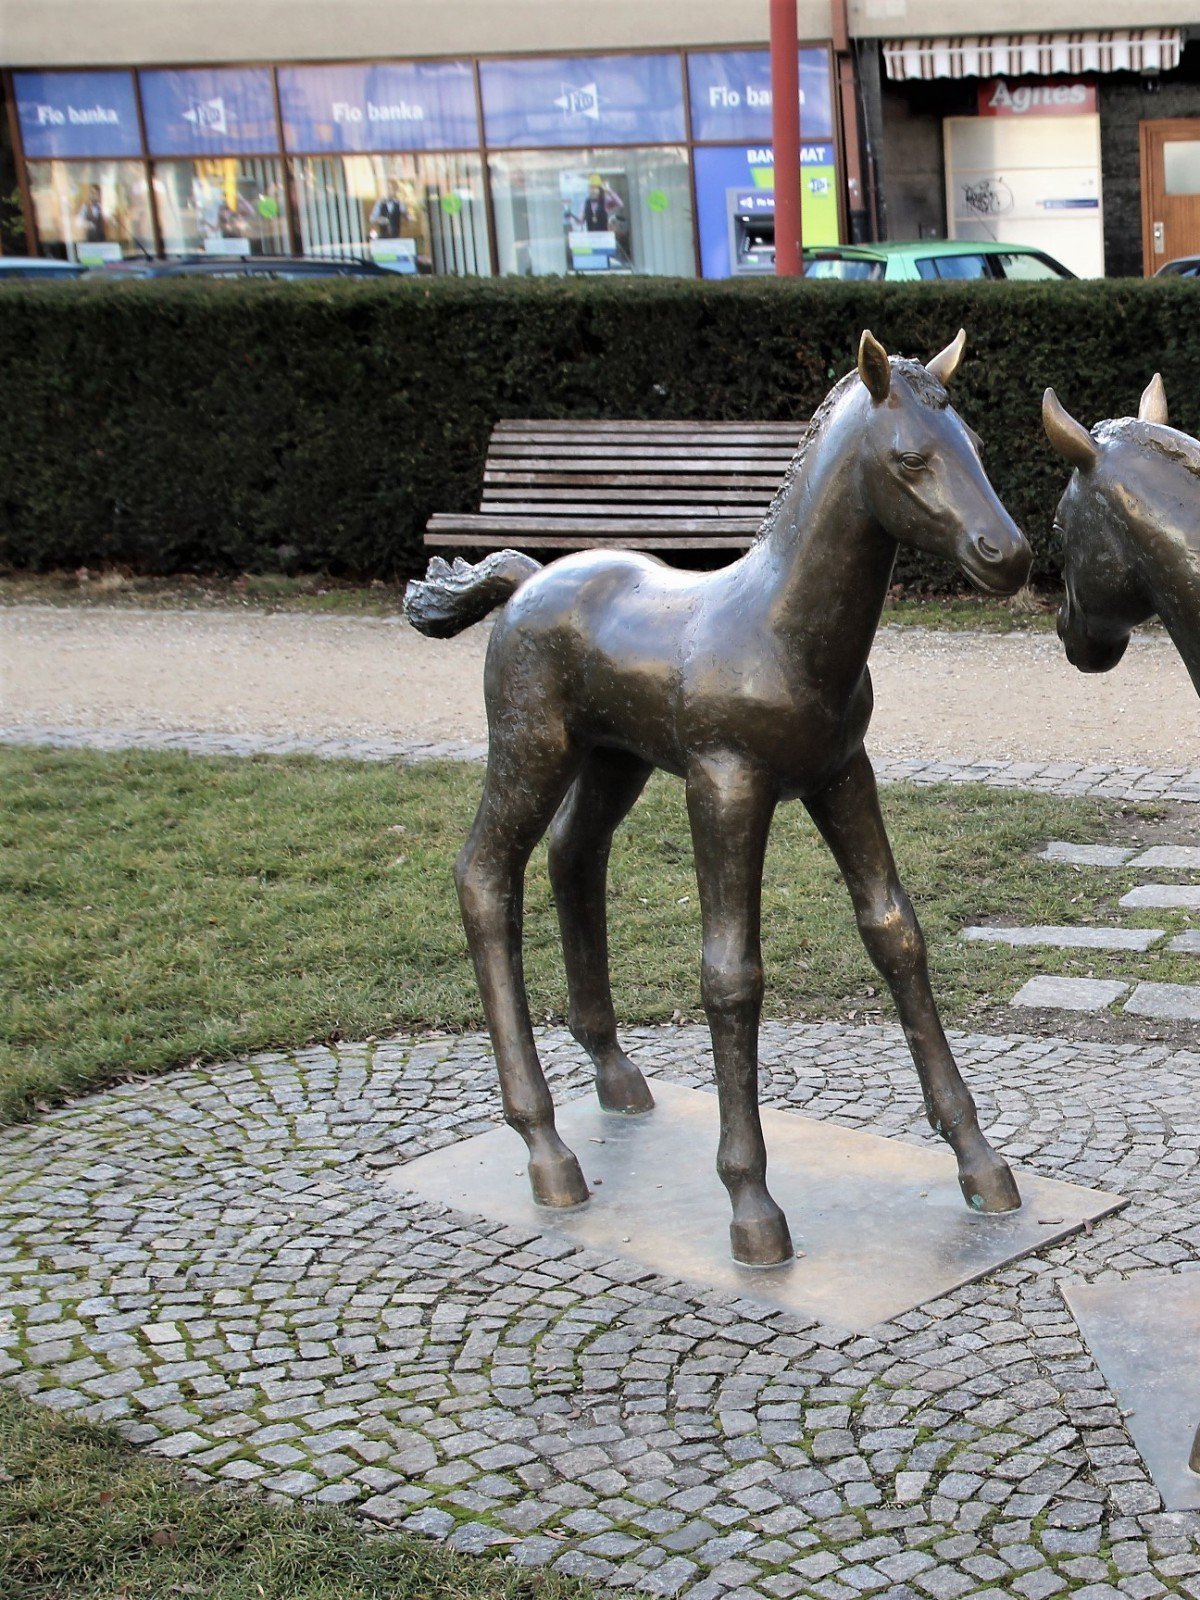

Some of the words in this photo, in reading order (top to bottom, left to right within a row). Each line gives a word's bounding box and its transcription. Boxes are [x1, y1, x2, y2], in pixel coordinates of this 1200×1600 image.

[709, 86, 740, 108] Fio
[988, 79, 1087, 113] Agnes
[37, 104, 66, 126] Fio
[67, 104, 119, 125] banka
[331, 102, 362, 124] Fio
[367, 101, 424, 123] banka
[746, 147, 826, 164] BANMAT
